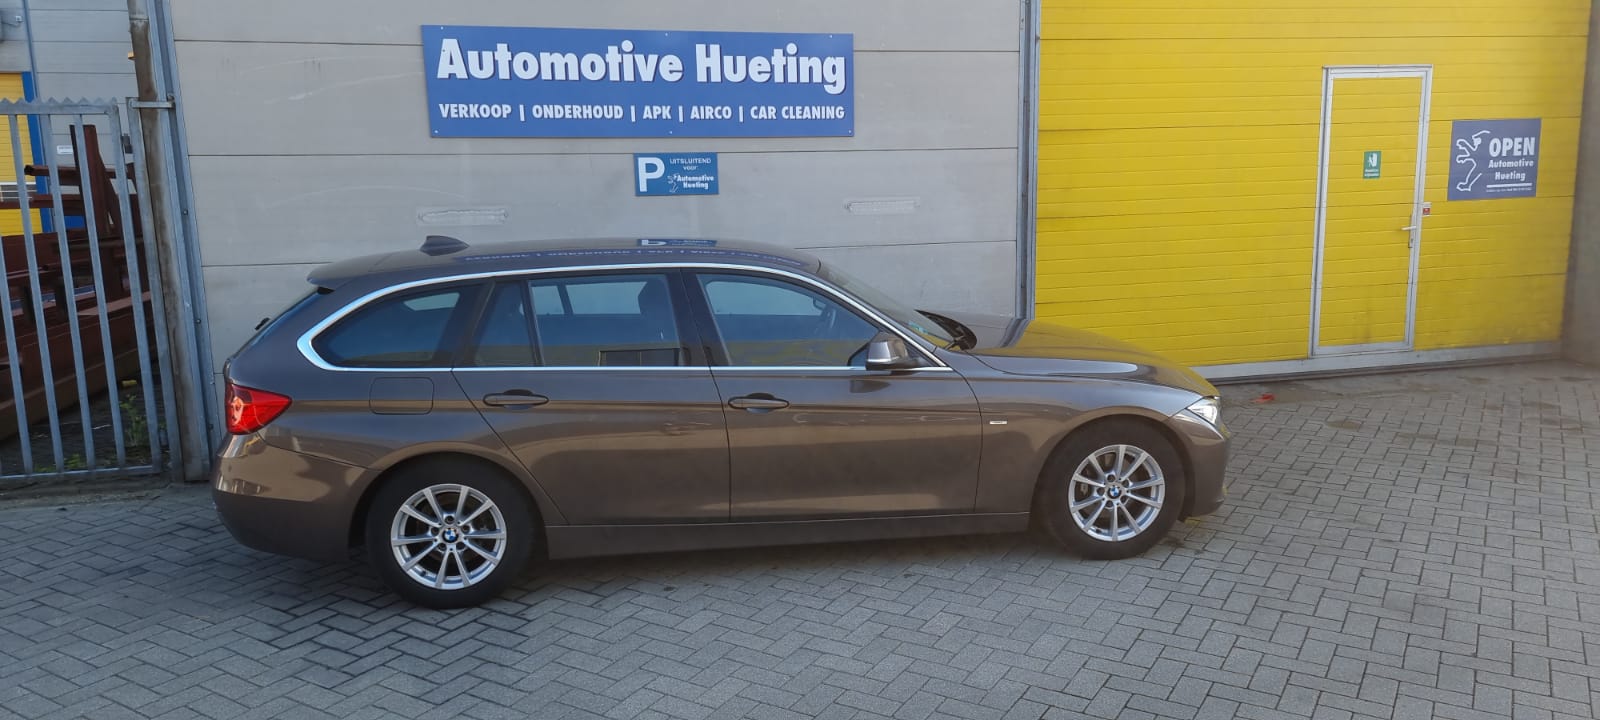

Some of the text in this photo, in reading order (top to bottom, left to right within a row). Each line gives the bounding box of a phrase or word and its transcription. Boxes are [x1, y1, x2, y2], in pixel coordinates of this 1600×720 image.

[437, 38, 847, 95] Automotive Hueting
[439, 103, 512, 119] VERKOOP
[532, 104, 624, 119] ONDERHOUD
[643, 105, 672, 119] APK
[690, 105, 732, 120] AIRCO
[750, 105, 777, 120] CAR
[781, 105, 845, 120] CLEANING
[1488, 136, 1536, 157] OPEN
[1488, 158, 1534, 169] Automotive
[637, 156, 665, 192] P
[676, 174, 715, 182] Automotive
[1494, 171, 1526, 182] Hueting
[683, 181, 709, 190] Hueting
